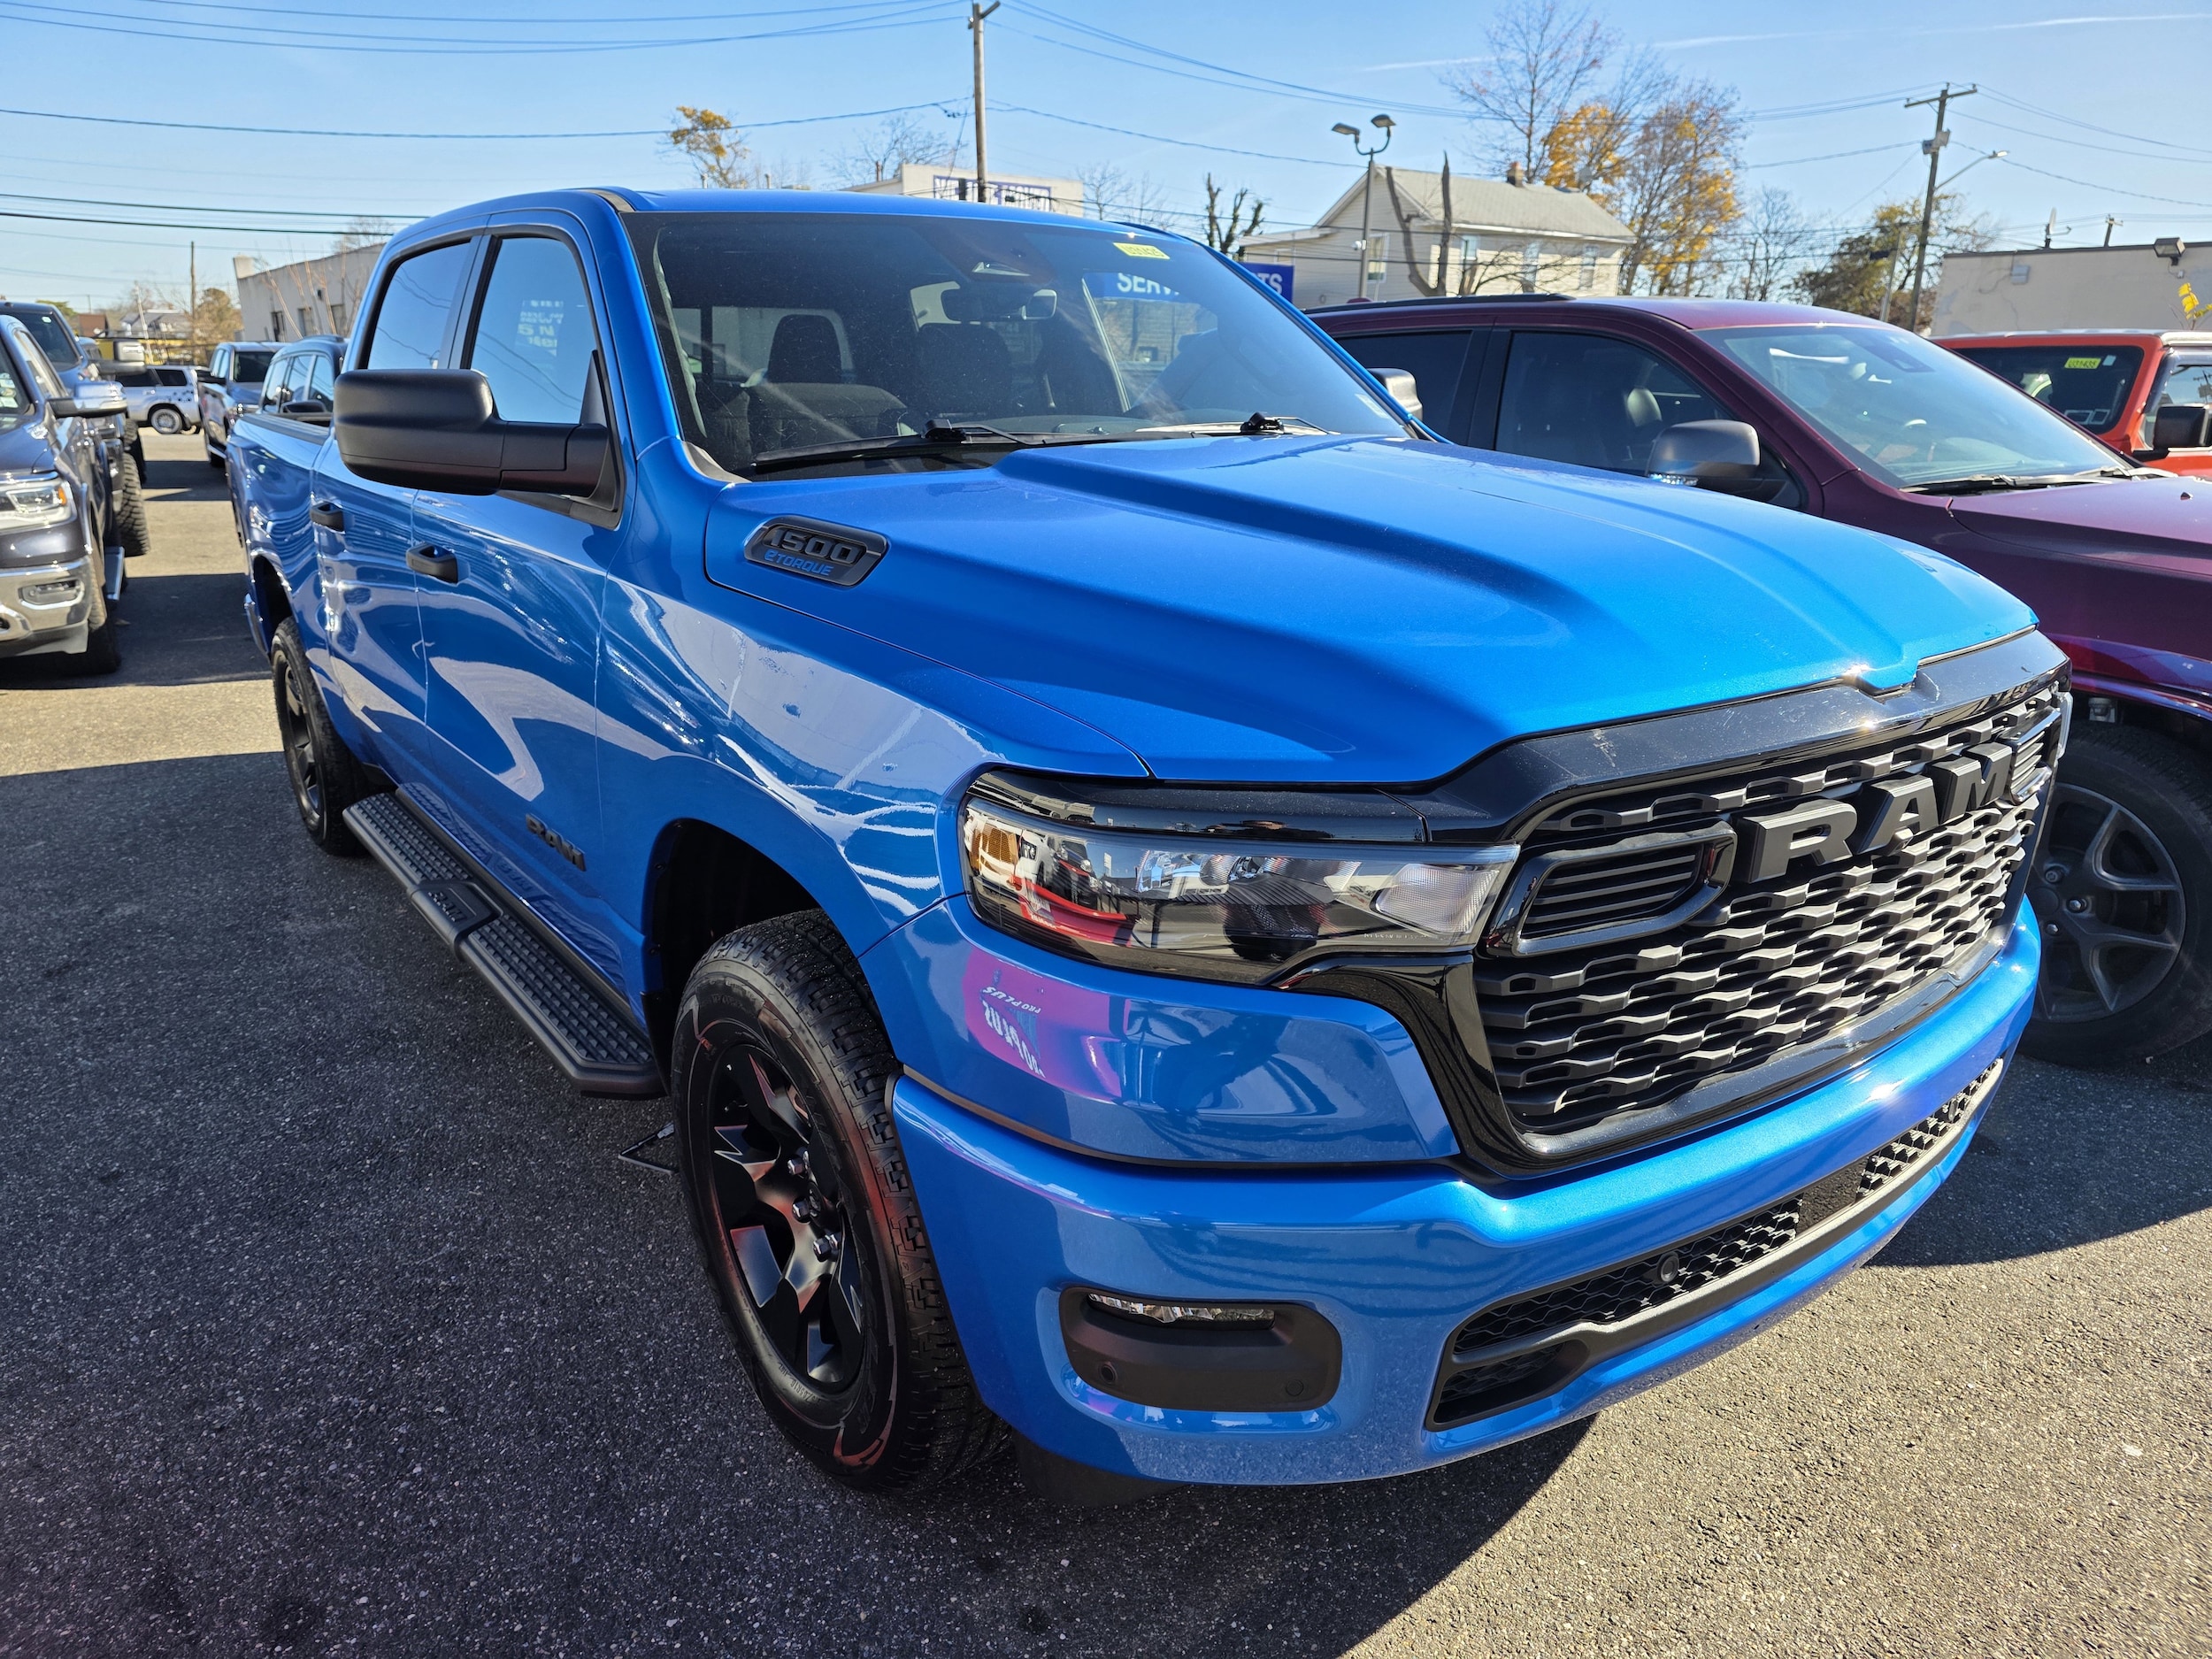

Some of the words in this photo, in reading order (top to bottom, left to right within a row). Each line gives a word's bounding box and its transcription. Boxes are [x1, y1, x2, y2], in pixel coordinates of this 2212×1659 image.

[769, 528, 862, 565] 1500
[525, 812, 588, 872] RAM
[1741, 741, 2013, 883] RAM
